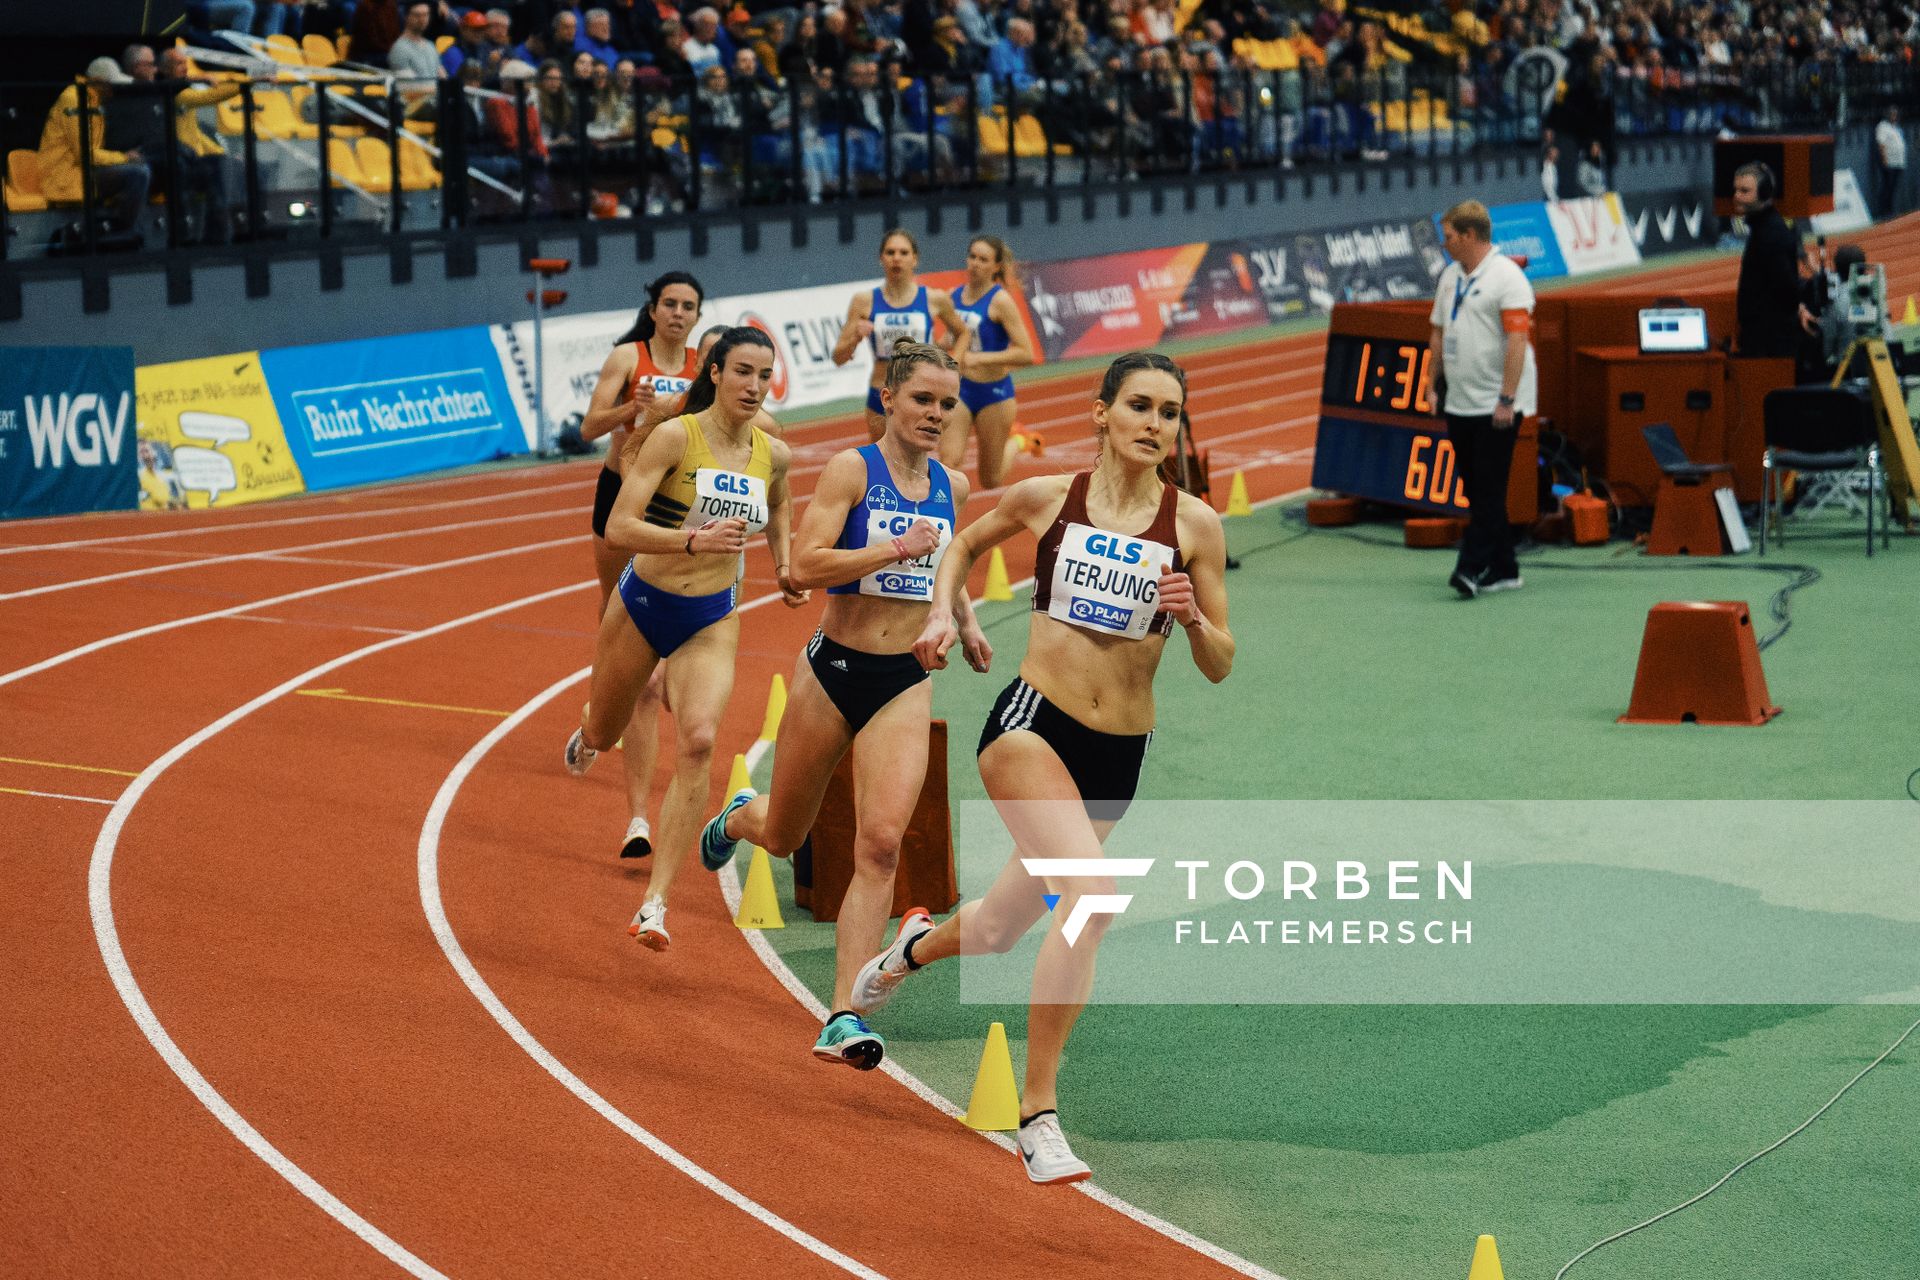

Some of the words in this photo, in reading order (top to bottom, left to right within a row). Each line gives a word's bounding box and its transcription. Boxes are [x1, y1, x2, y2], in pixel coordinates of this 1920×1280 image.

[655, 378, 686, 393] GLS
[304, 399, 363, 442] Ruhr
[362, 384, 492, 433] Nachrichten
[24, 390, 130, 469] WGV
[700, 496, 762, 524] TORTELL
[868, 495, 896, 506] BAYER
[905, 578, 926, 589] PLAN
[1064, 558, 1158, 604] TERJUNG
[1094, 606, 1130, 624] PLAN
